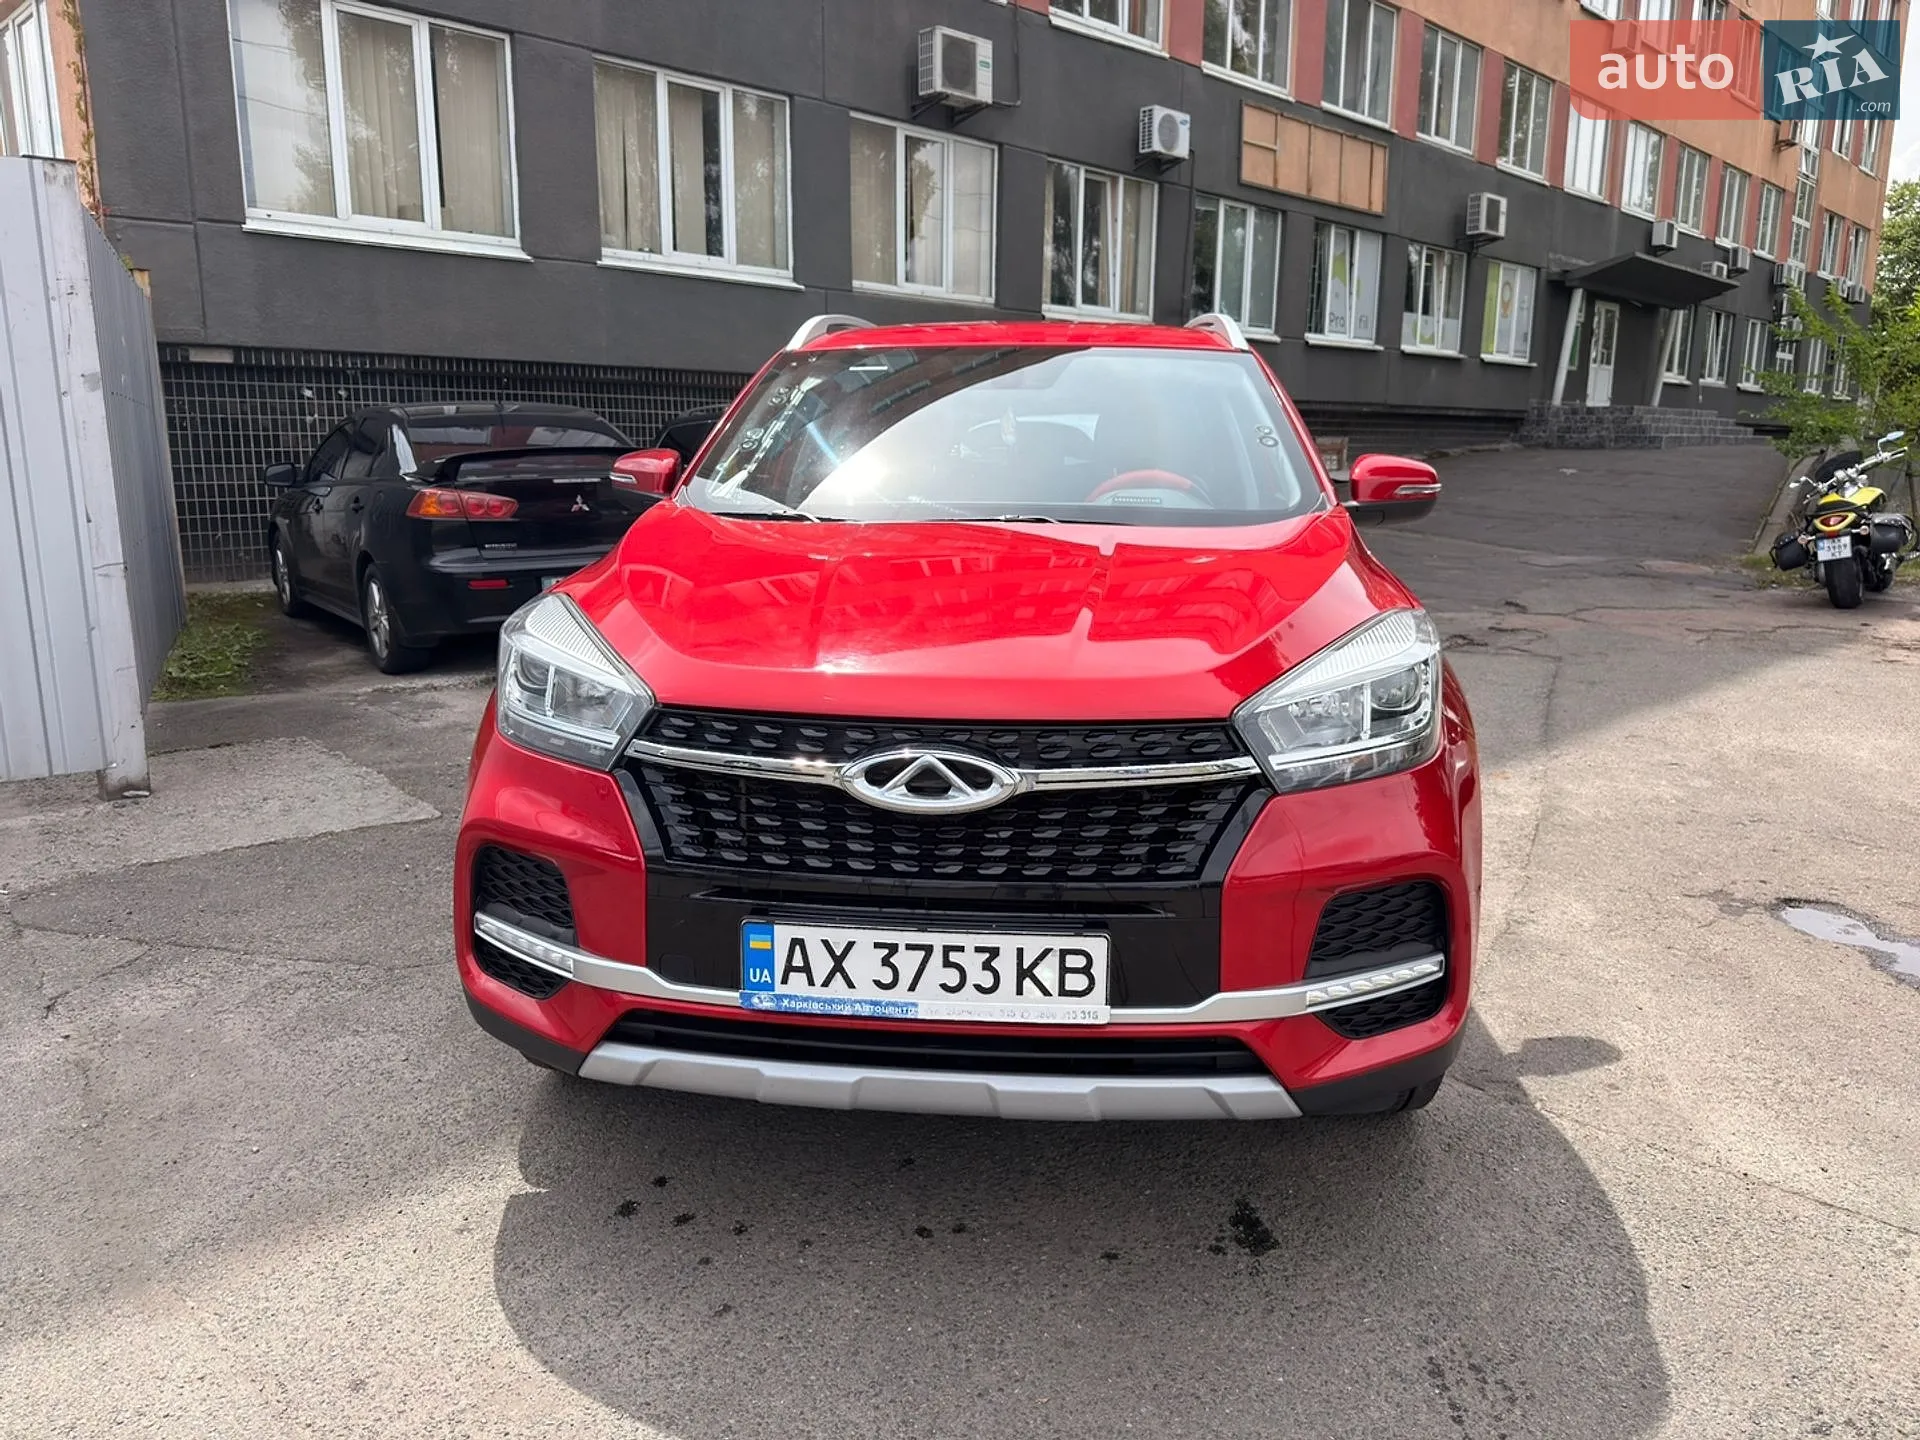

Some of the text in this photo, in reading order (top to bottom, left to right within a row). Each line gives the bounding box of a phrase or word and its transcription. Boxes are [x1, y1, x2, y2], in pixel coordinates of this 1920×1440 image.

[749, 967, 771, 984] UA
[780, 937, 1096, 998] AX 3753 KB
